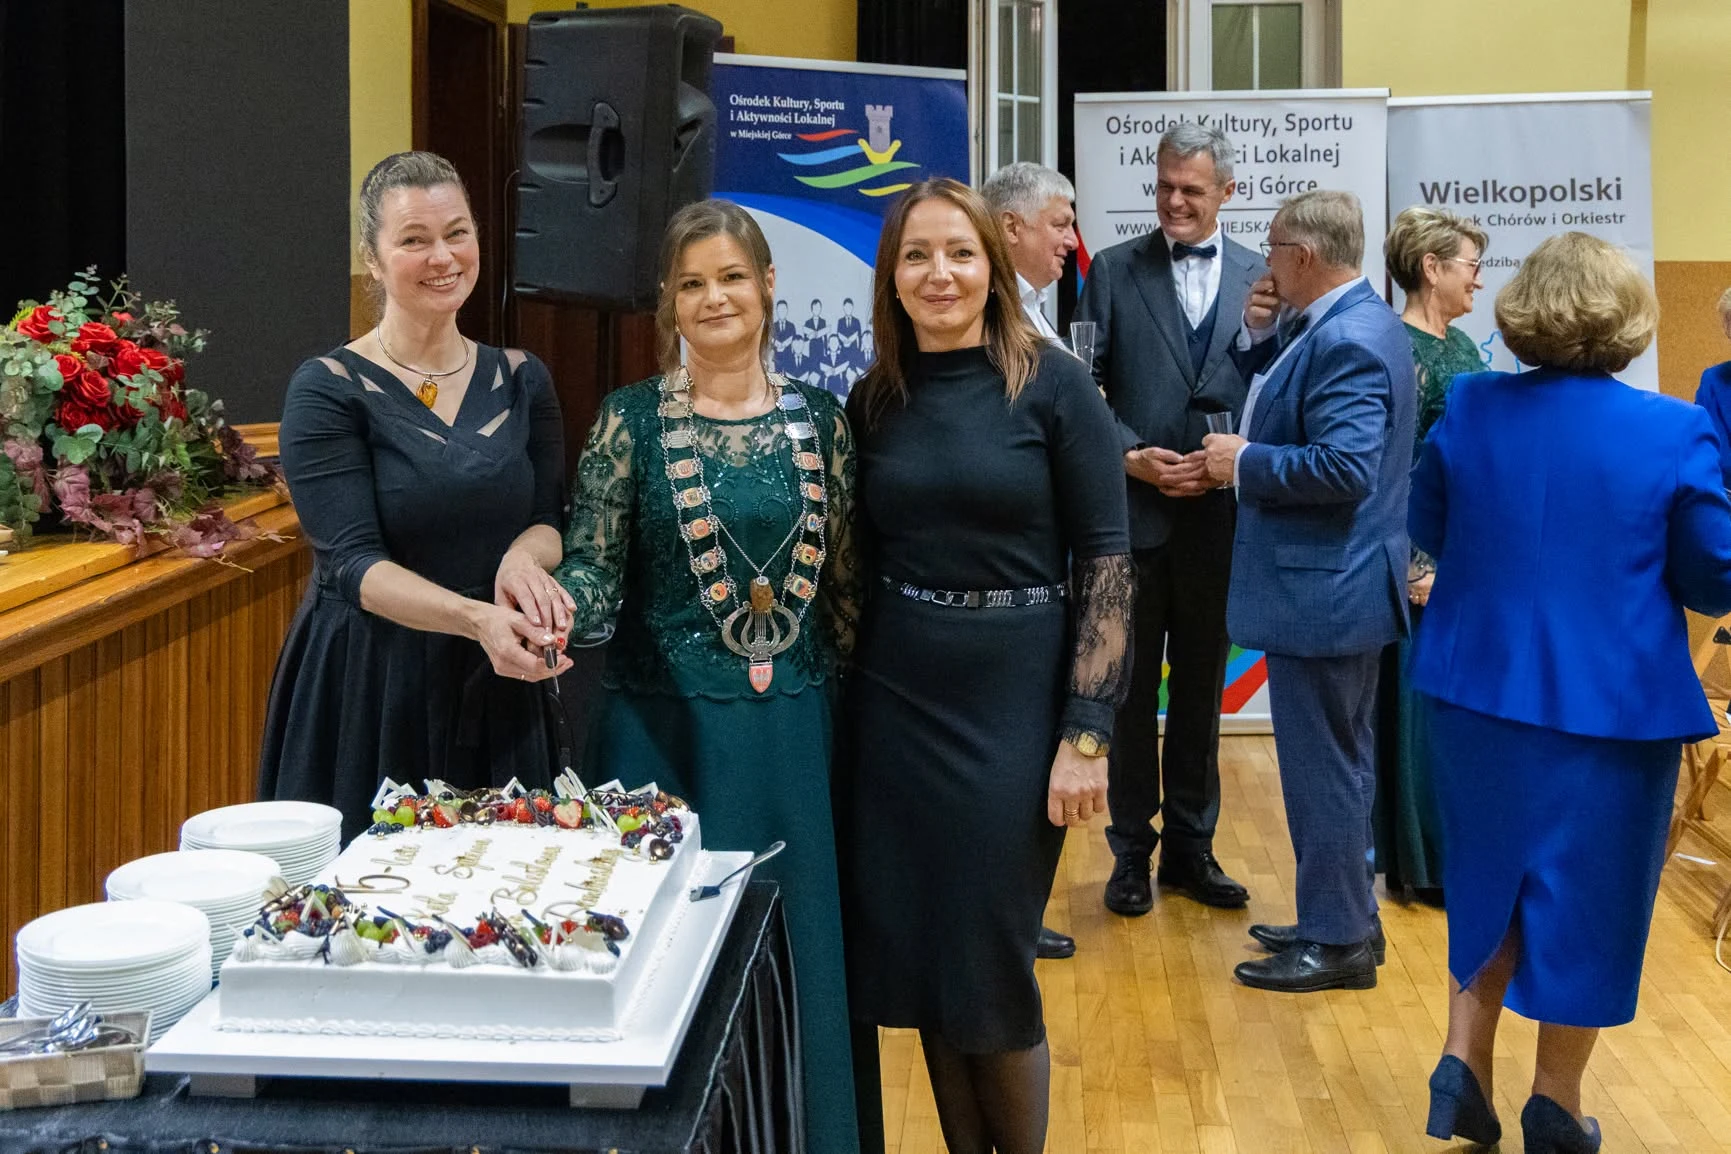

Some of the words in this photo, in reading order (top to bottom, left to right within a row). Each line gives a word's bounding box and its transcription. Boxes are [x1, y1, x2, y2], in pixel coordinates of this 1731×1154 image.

[729, 94, 771, 107] Ośrodek
[773, 95, 813, 112] Kultury,
[814, 98, 845, 112] Sportu
[730, 110, 734, 121] i
[736, 110, 792, 125] Aktywności
[794, 112, 836, 127] Lokalnej
[1285, 112, 1353, 137] Sportu
[738, 129, 771, 141] Miejskiej
[772, 130, 792, 140] Górce
[1120, 146, 1124, 166] i
[1254, 142, 1340, 168] Lokalnej
[1260, 174, 1318, 195] Górce
[1420, 177, 1622, 208] Wielkopolski
[1487, 213, 1546, 227] Chórów
[1552, 212, 1556, 226] i
[1561, 211, 1626, 226] Orkiestr
